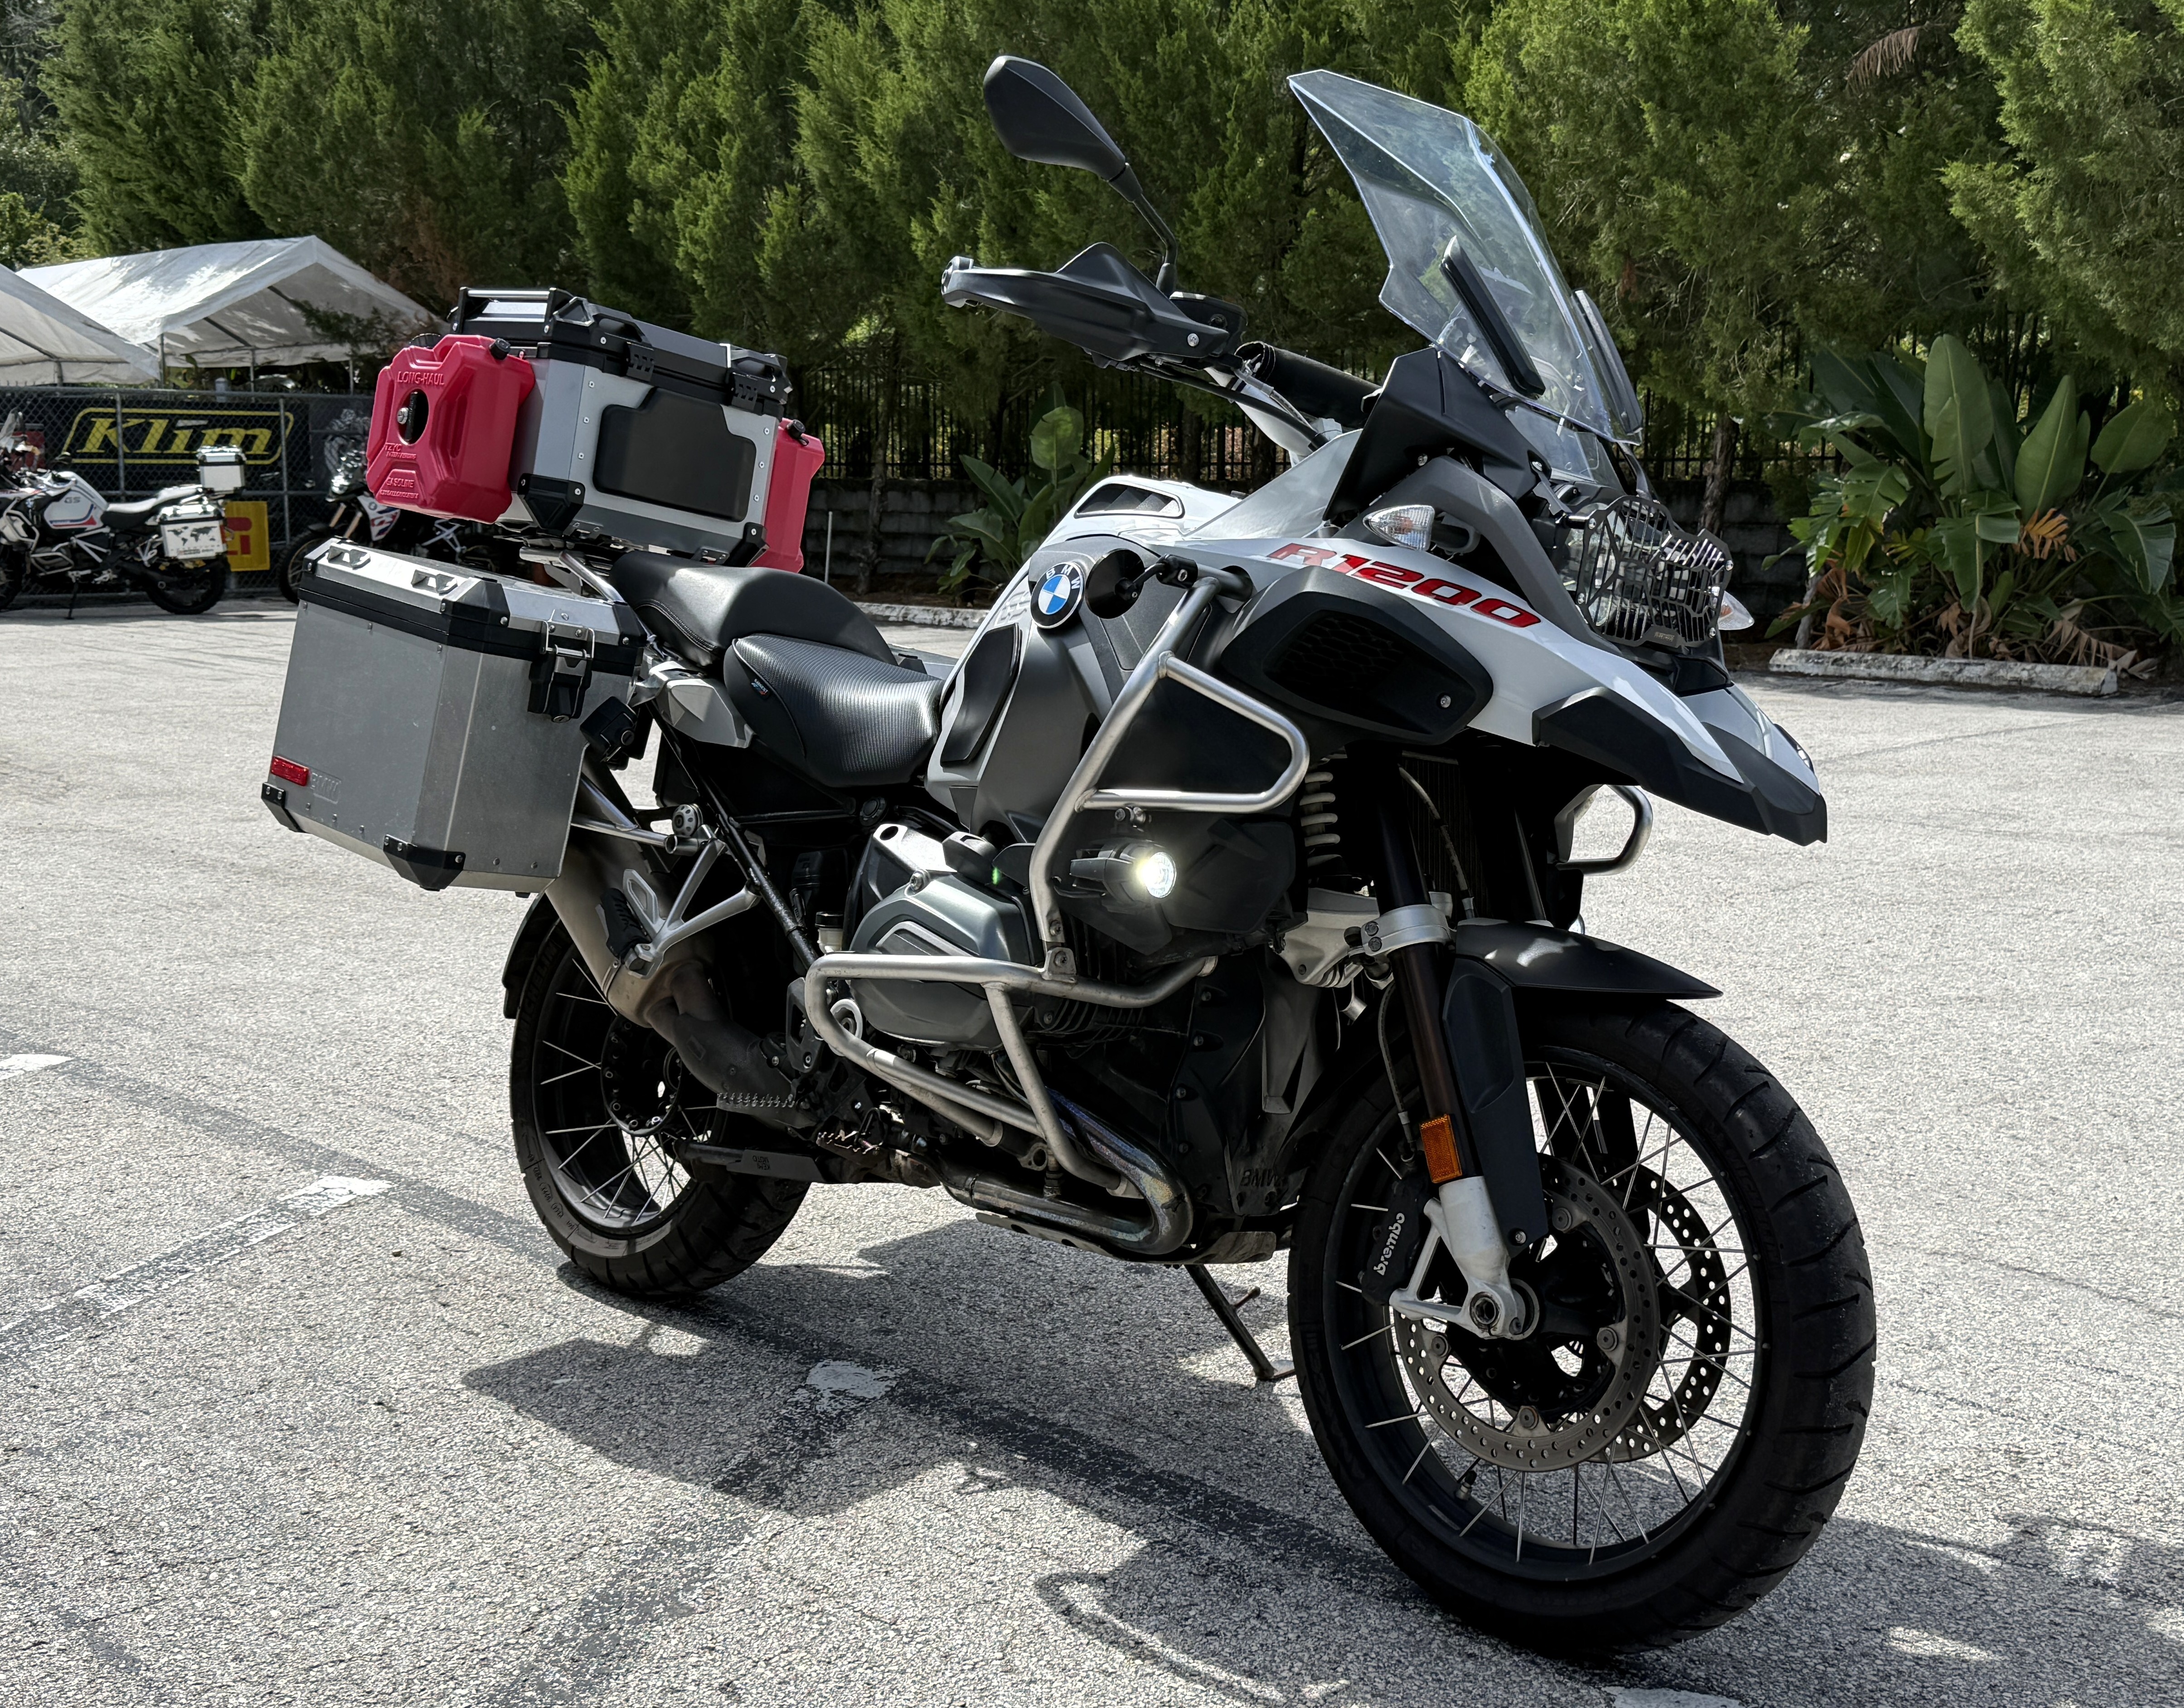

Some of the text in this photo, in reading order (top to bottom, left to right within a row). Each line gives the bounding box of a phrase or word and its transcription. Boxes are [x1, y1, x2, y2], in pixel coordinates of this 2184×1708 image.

[398, 371, 444, 385] LONG-HAUL
[386, 477, 415, 488] GASOLINE
[1046, 564, 1081, 589] BMW
[1267, 543, 1541, 628] R1200
[1373, 1212, 1405, 1275] brembo
